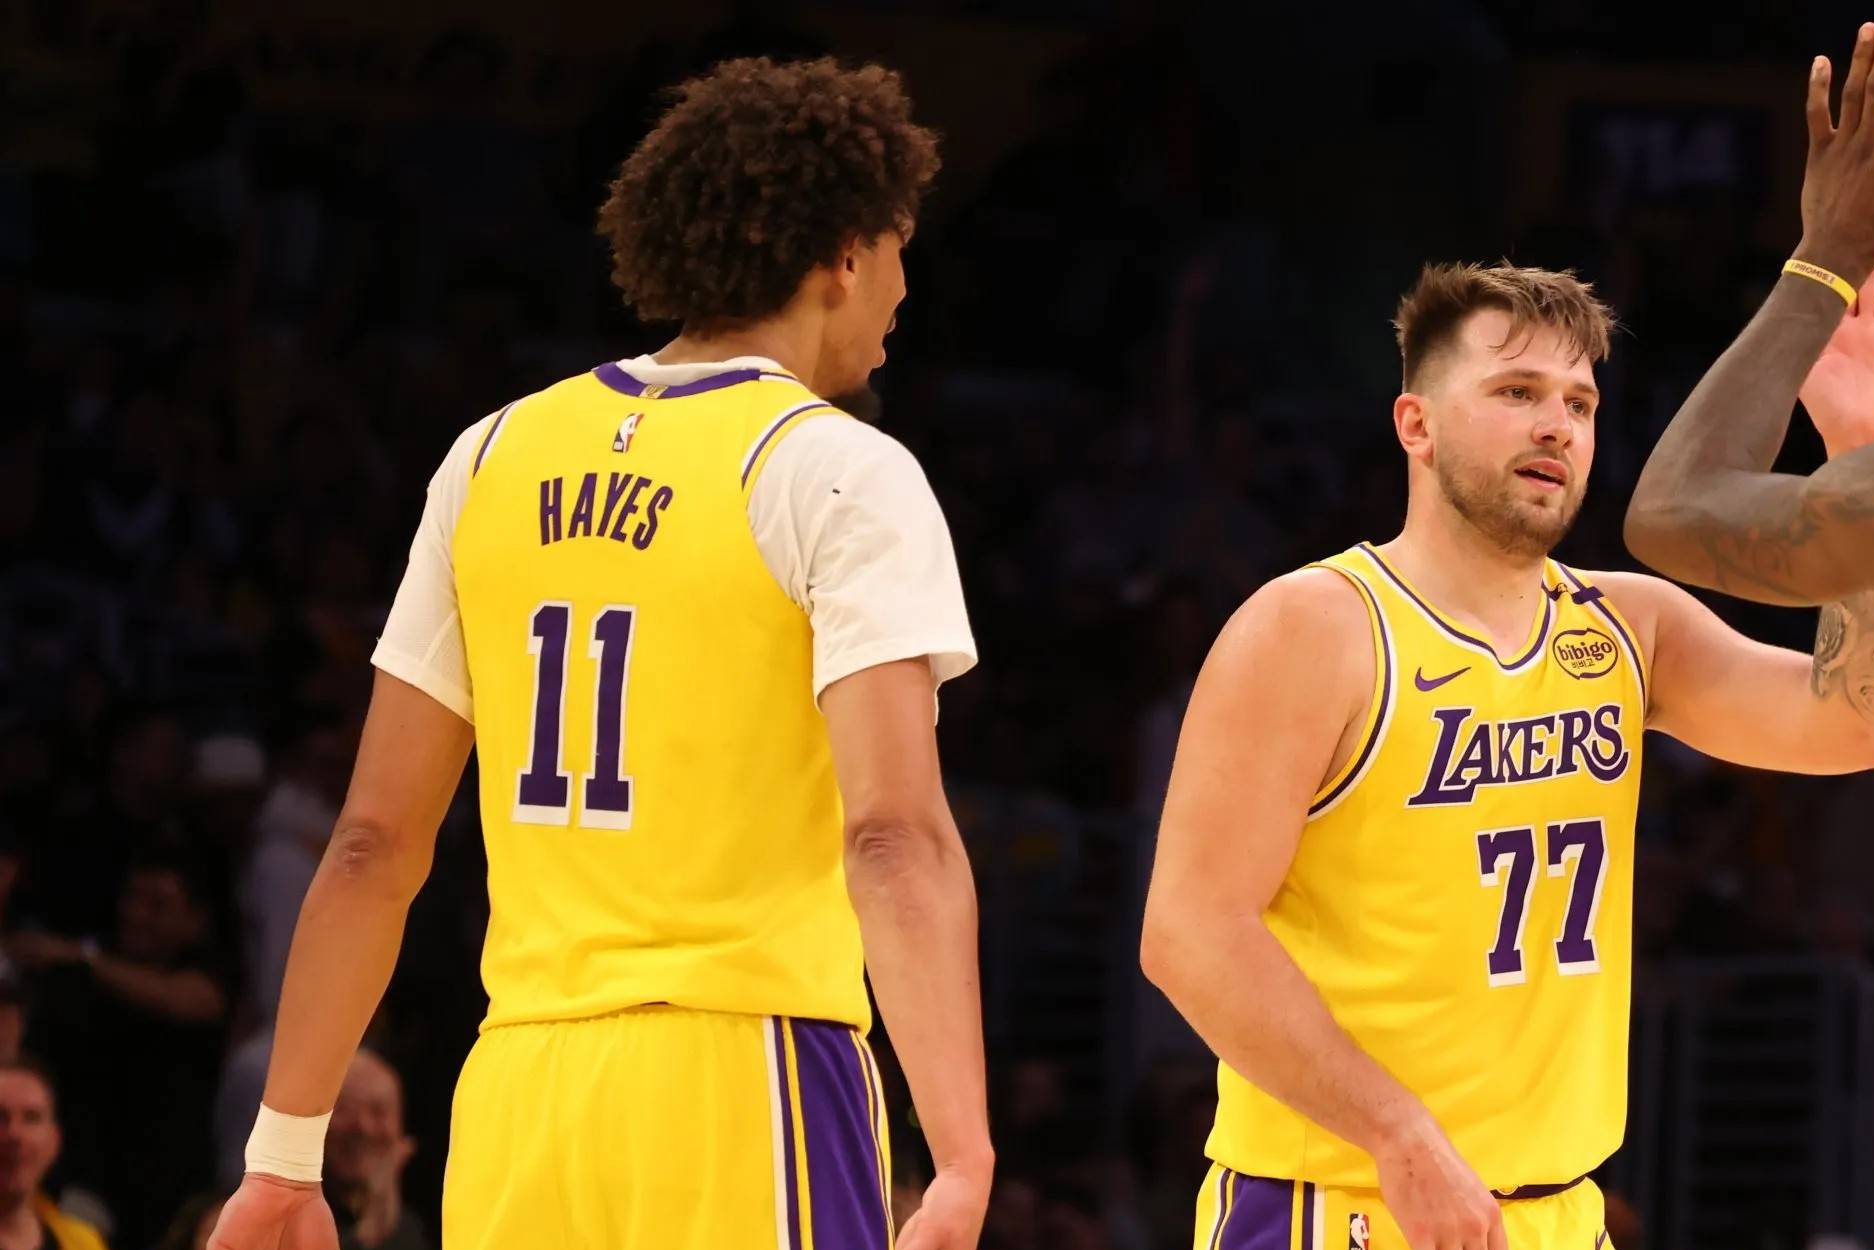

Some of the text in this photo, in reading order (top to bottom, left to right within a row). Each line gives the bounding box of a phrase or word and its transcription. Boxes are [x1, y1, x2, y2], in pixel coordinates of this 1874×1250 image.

[540, 472, 674, 551] HAYES
[1556, 641, 1613, 662] bibigo
[513, 600, 637, 830] 11
[1405, 702, 1631, 809] LAKERS
[1475, 816, 1609, 988] 77
